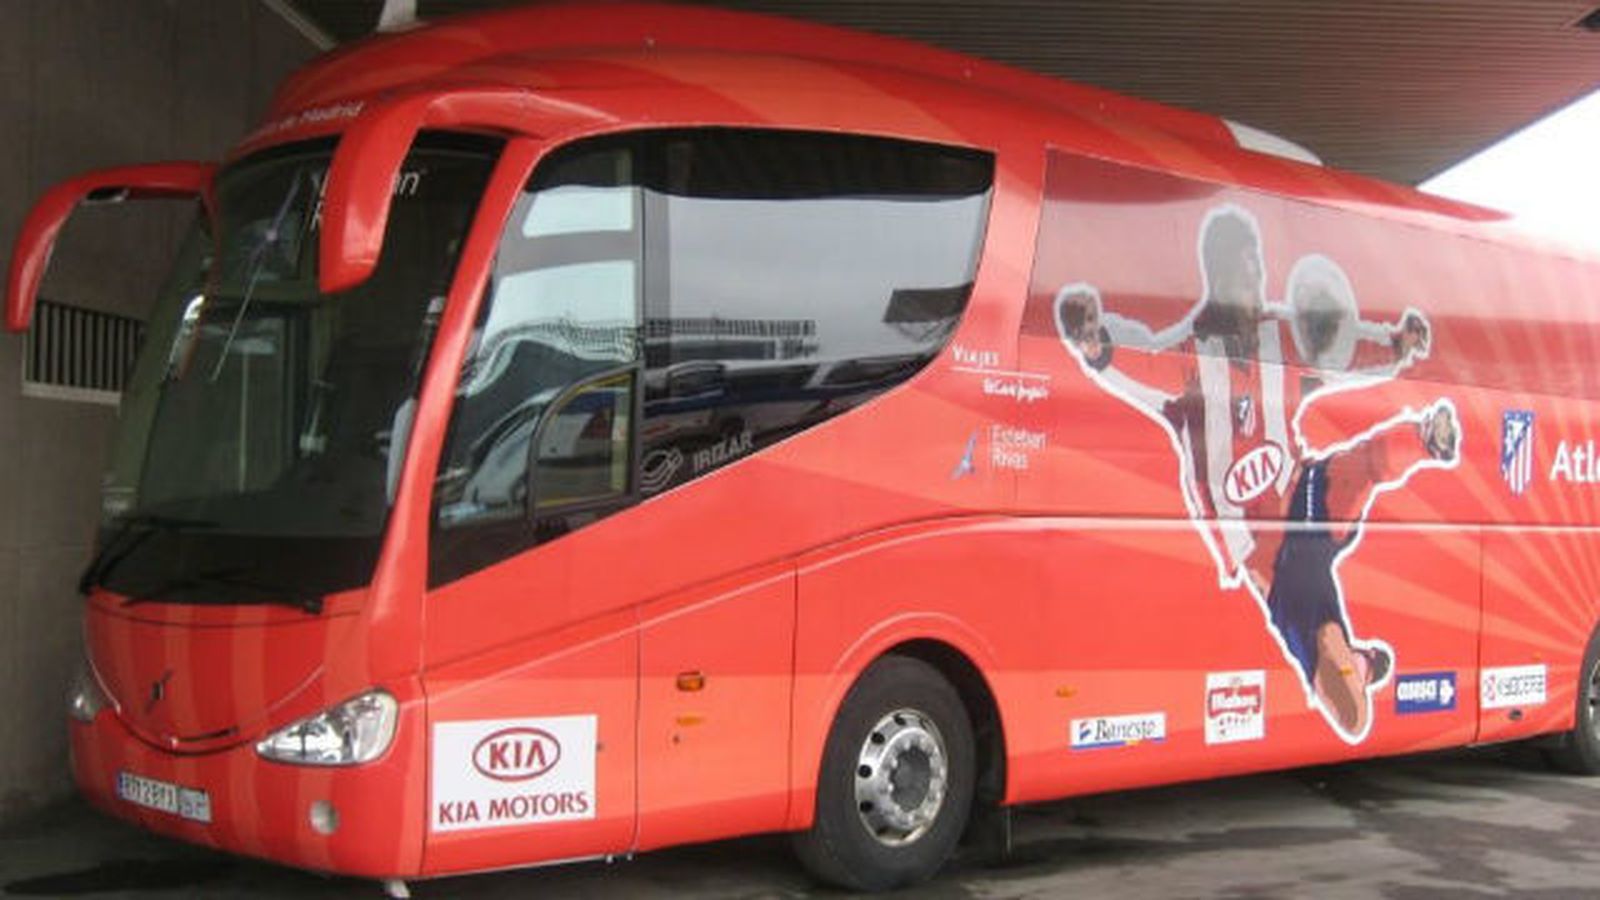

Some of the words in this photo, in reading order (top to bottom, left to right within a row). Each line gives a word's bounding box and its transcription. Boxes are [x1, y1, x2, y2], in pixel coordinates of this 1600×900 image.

[693, 430, 753, 472] IRIZAR
[991, 424, 1046, 450] Esteban
[991, 448, 1028, 469] Rivas
[1234, 450, 1276, 498] KIA
[1094, 719, 1156, 741] Banesto
[489, 739, 547, 769] KIA
[438, 800, 480, 825] KIA
[488, 790, 589, 821] MOTORS
